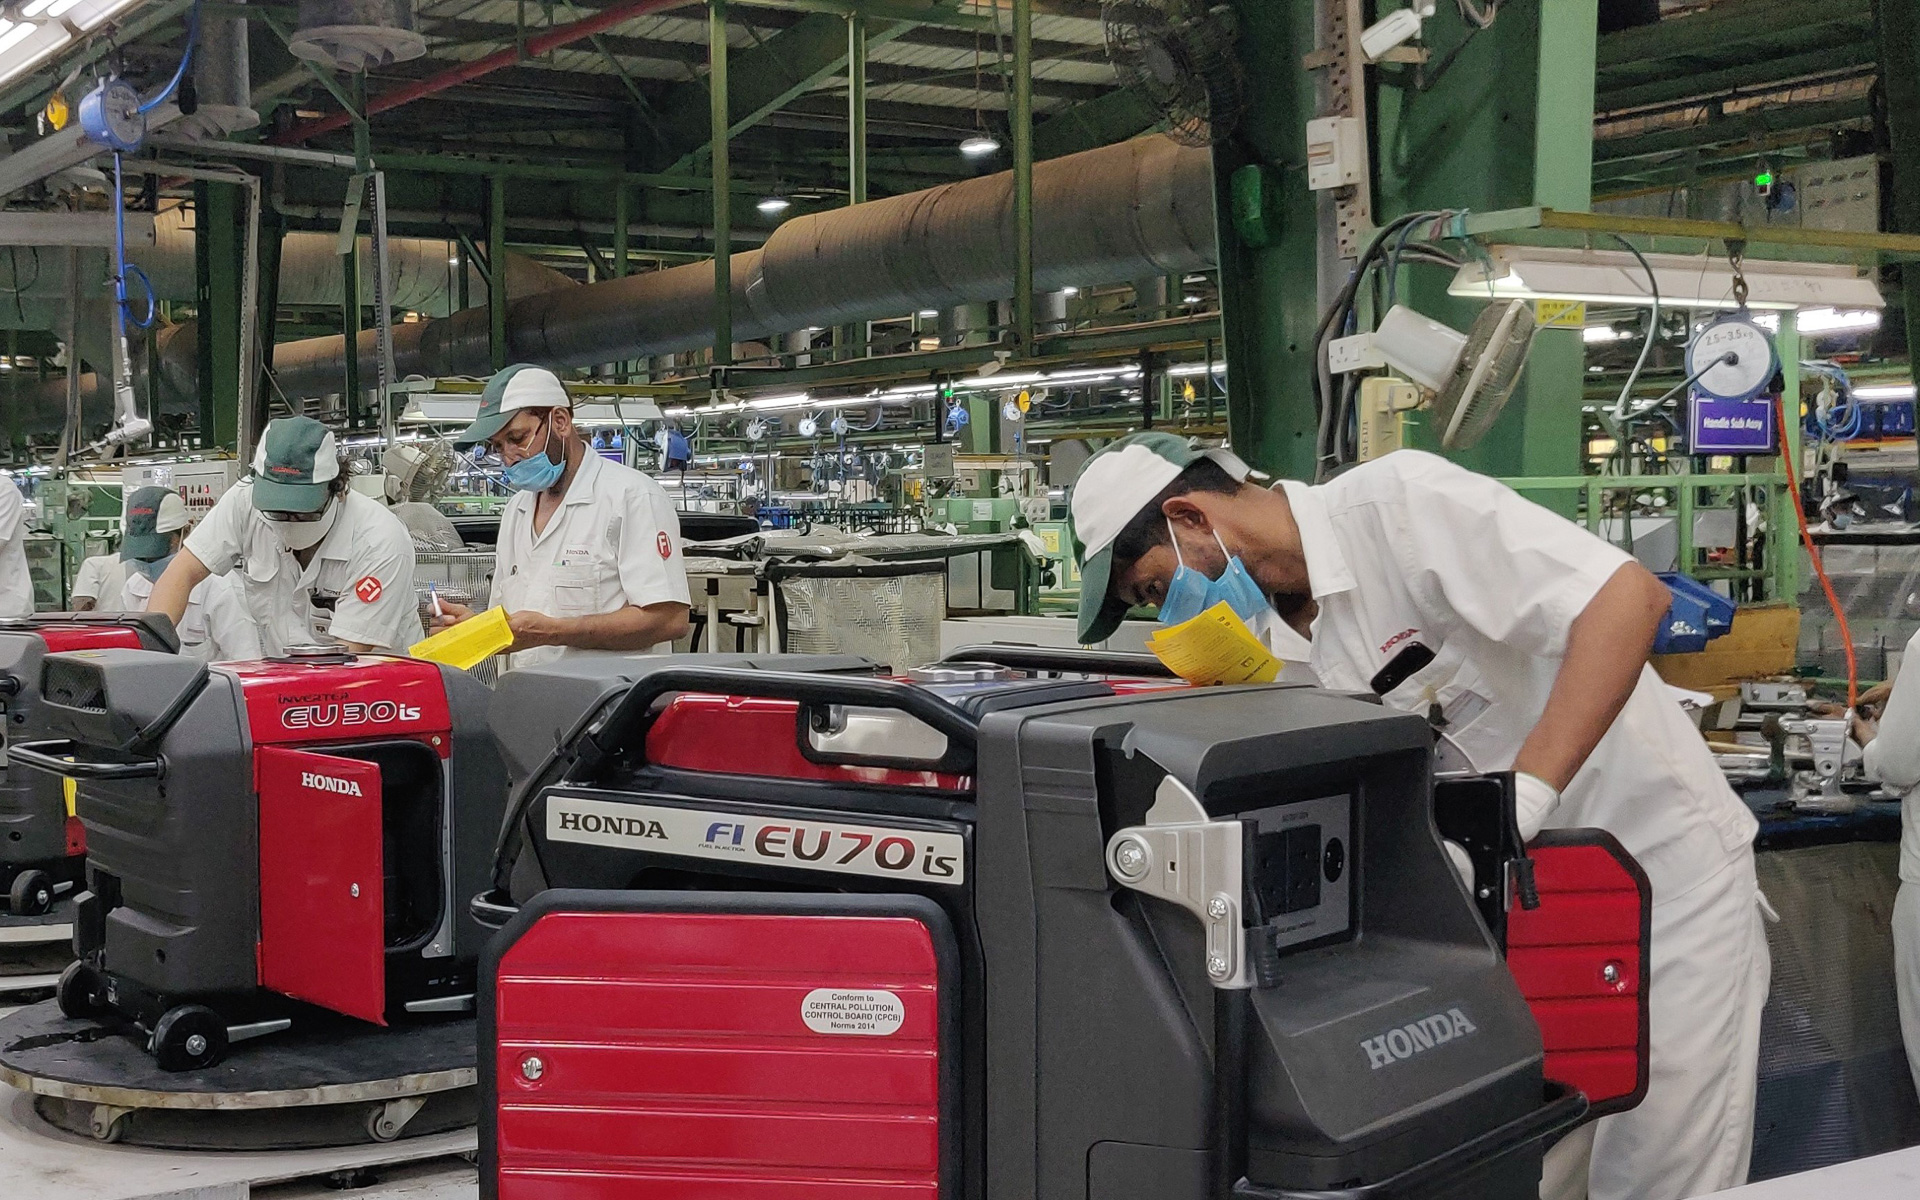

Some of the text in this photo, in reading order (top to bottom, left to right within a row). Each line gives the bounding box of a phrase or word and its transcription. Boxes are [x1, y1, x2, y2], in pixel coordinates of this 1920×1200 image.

[357, 578, 381, 602] FI
[301, 772, 362, 797] HONDA
[559, 812, 669, 840] HONDA
[705, 822, 745, 846] FI
[831, 993, 875, 1002] Conform to
[810, 1002, 894, 1012] CENTRAL POLLUTION
[804, 1011, 901, 1022] CONTROL BOARD (CPCB)
[830, 1021, 875, 1030] Norms 2014
[1360, 1007, 1477, 1070] HONDA
